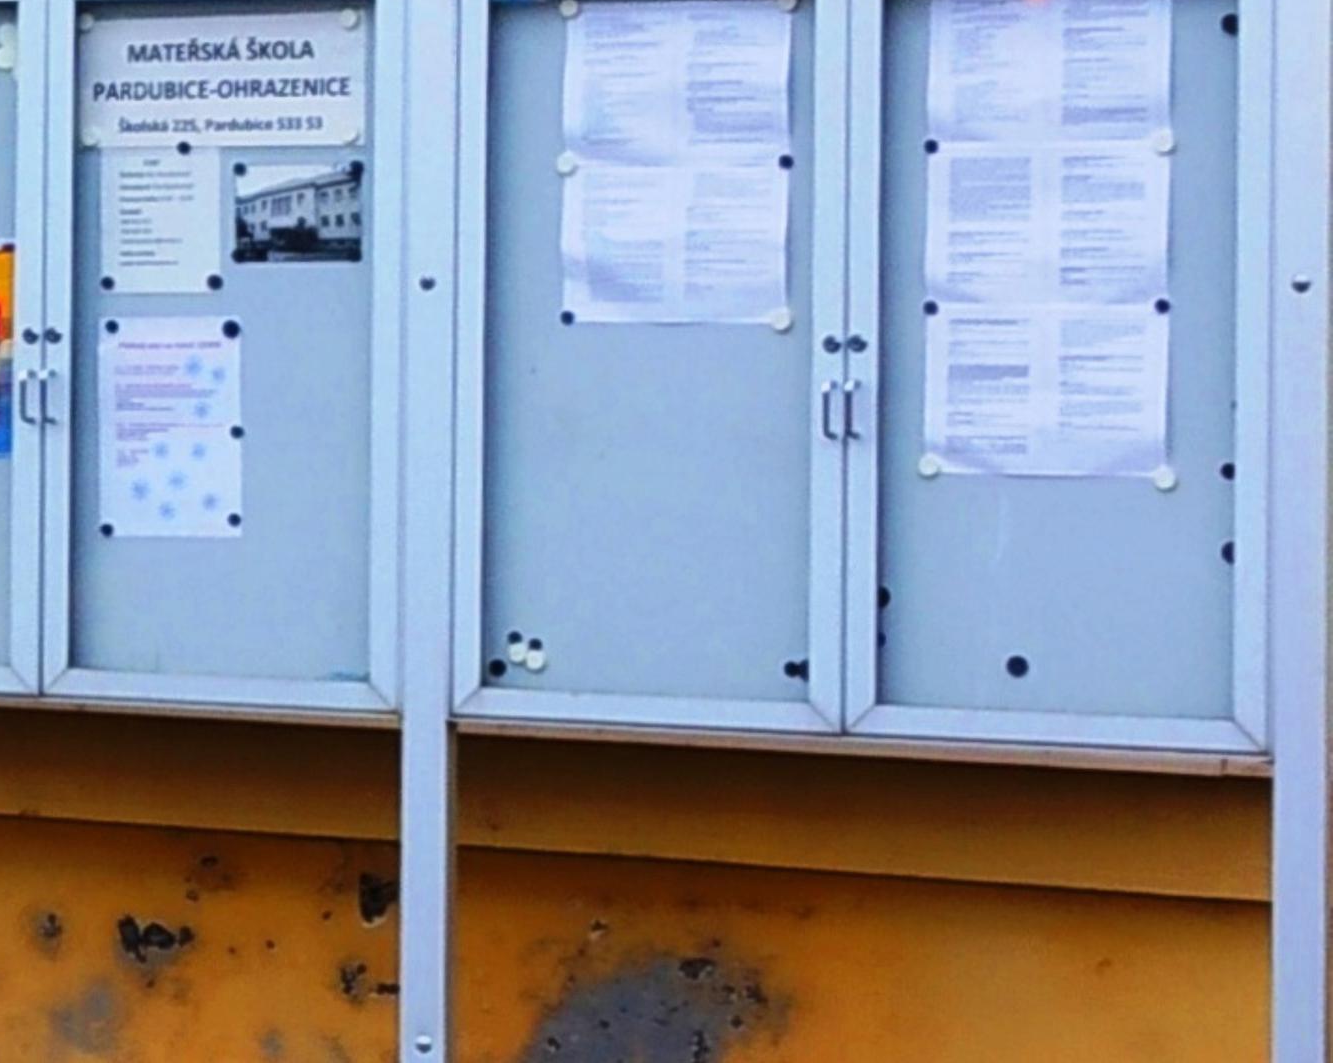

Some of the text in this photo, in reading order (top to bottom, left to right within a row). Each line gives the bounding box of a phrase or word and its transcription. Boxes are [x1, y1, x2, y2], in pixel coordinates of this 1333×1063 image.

[127, 36, 315, 63] MATEŘSKÁ ŠKOLA
[93, 77, 351, 102] PARDUBICE-OHRAZENICE
[118, 117, 169, 133] Školská
[205, 117, 273, 132] Pardubice
[305, 116, 323, 130] 53
